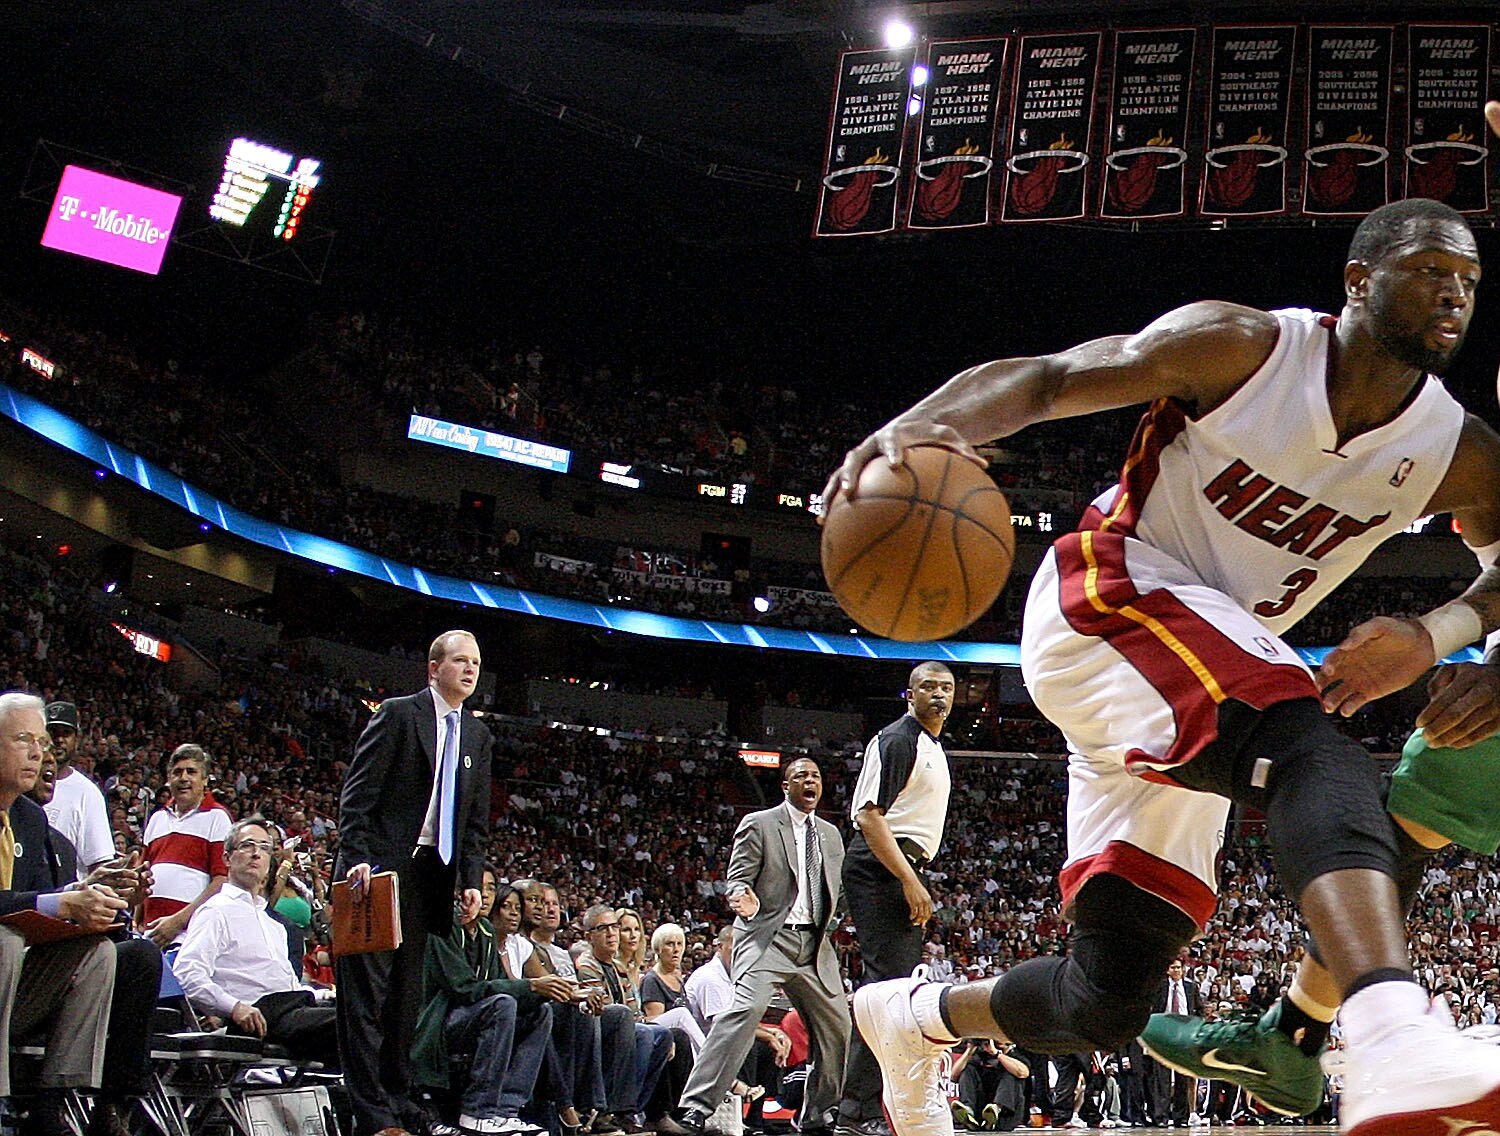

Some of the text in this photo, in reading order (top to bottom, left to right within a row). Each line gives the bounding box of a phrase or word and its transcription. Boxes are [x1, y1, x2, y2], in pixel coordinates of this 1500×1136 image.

[1124, 43, 1179, 54] MIAMI
[1224, 40, 1279, 50] MIAMI
[1321, 39, 1376, 49] MIAMI
[1420, 39, 1474, 48] MIAMI
[1030, 47, 1084, 59] MIAMI
[1134, 50, 1183, 64] HEAT
[1234, 47, 1283, 60] HEAT
[1331, 46, 1381, 59] HEAT
[1430, 46, 1479, 59] HEAT
[937, 53, 991, 66] MIAMI
[1039, 54, 1088, 68] HEAT
[849, 62, 901, 75] MIAMI
[946, 59, 994, 75] HEAT
[858, 68, 905, 84] HEAT
[1122, 85, 1180, 94] ATLANTIC
[1220, 82, 1279, 90] SOUTHEAST
[1318, 81, 1378, 89] SOUTHEAST
[1026, 89, 1084, 98] ATLANTIC
[1219, 92, 1279, 101] DIVISION
[1318, 91, 1378, 100] DIVISION
[1418, 90, 1479, 98] DIVISION
[933, 94, 989, 105] ATLANTIC
[1024, 99, 1083, 109] DIVISION
[1120, 95, 1180, 105] DIVISION
[1417, 100, 1478, 108] CHAMPIONS
[843, 103, 899, 115] ATLANTIC
[931, 105, 988, 115] DIVISION
[1120, 106, 1179, 116] CHAMPIONS
[1218, 102, 1278, 112] CHAMPIONS
[1316, 102, 1378, 110] CHAMPIONS
[842, 113, 898, 125] DIVISION
[1023, 109, 1081, 119] CHAMPIONS
[930, 115, 987, 126] CHAMPIONS
[840, 123, 896, 136] CHAMPIONS
[779, 494, 803, 507] FGA
[1203, 458, 1391, 561] HEAT
[1010, 512, 1052, 527] FTA 21
[1253, 567, 1318, 618] 3
